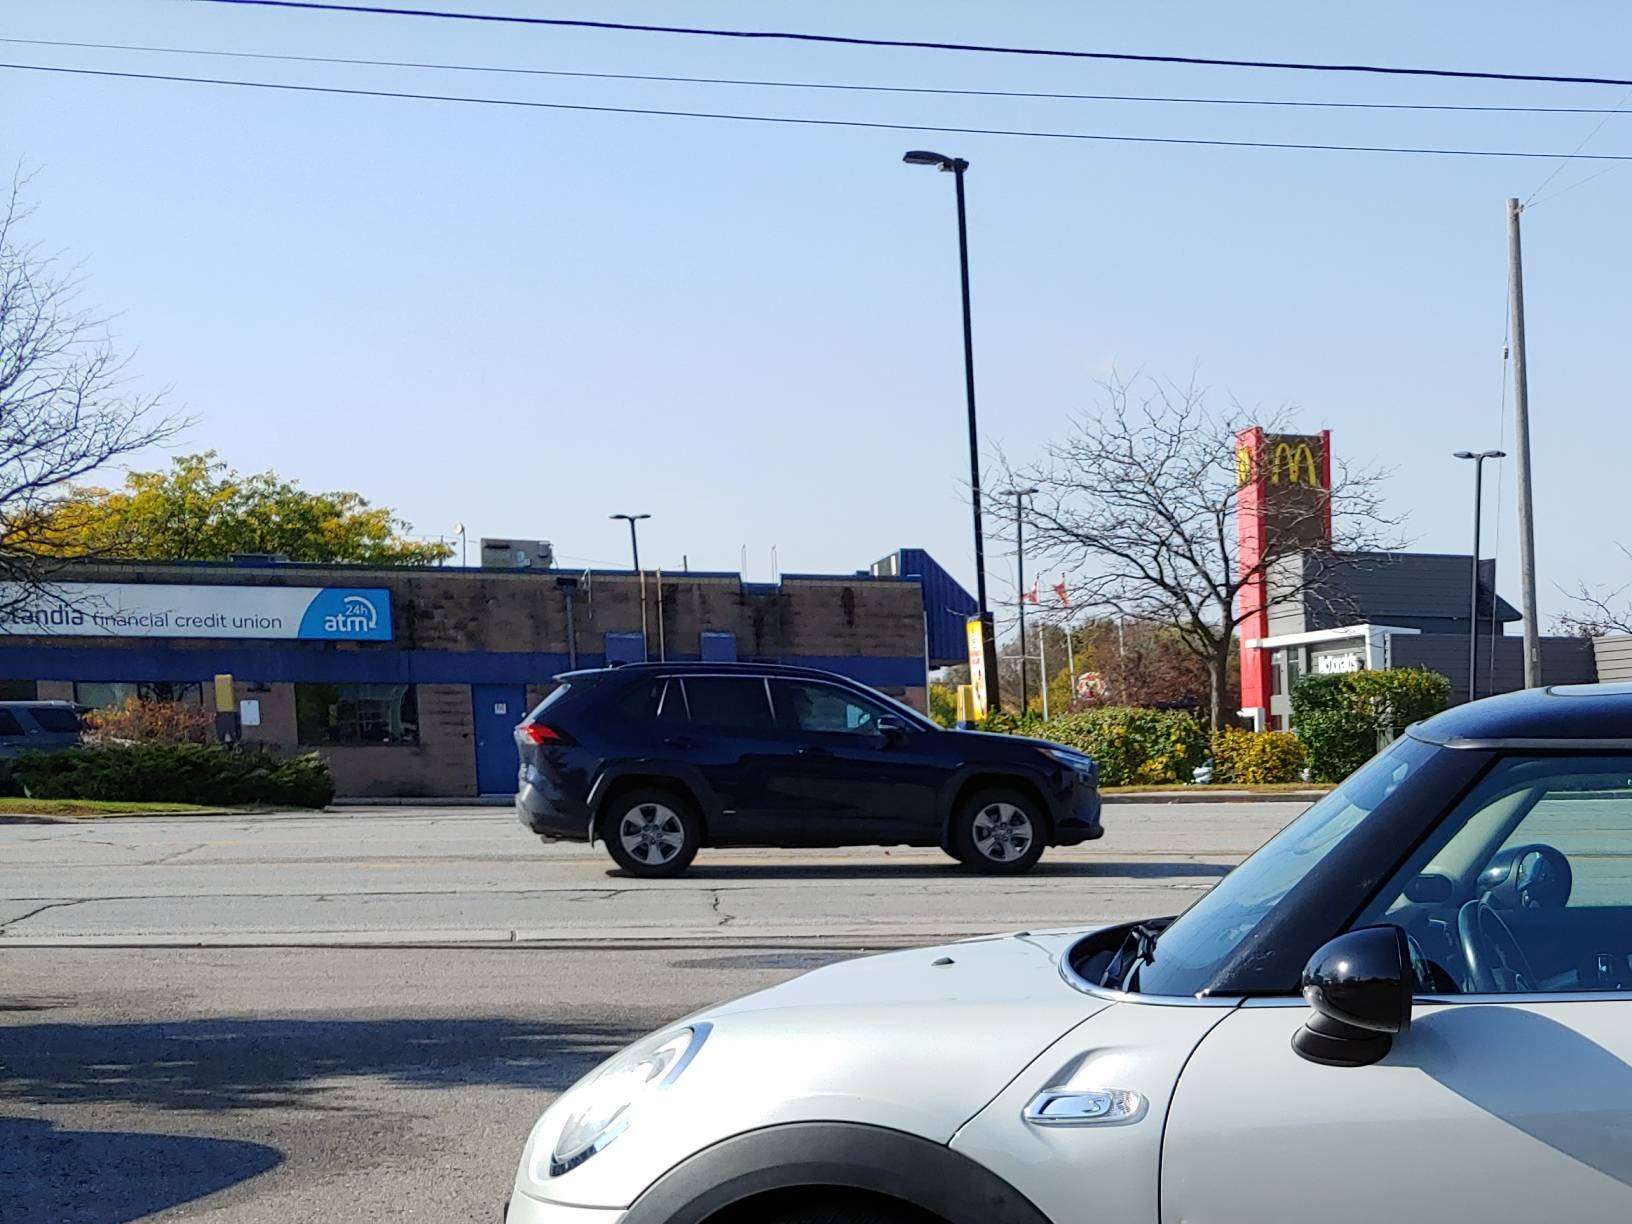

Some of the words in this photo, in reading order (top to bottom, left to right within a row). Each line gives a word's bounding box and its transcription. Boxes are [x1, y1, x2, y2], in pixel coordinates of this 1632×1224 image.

[345, 604, 368, 616] 24h
[94, 611, 169, 628] financial
[175, 613, 227, 628] credit
[233, 614, 282, 629] union
[324, 613, 368, 632] atm
